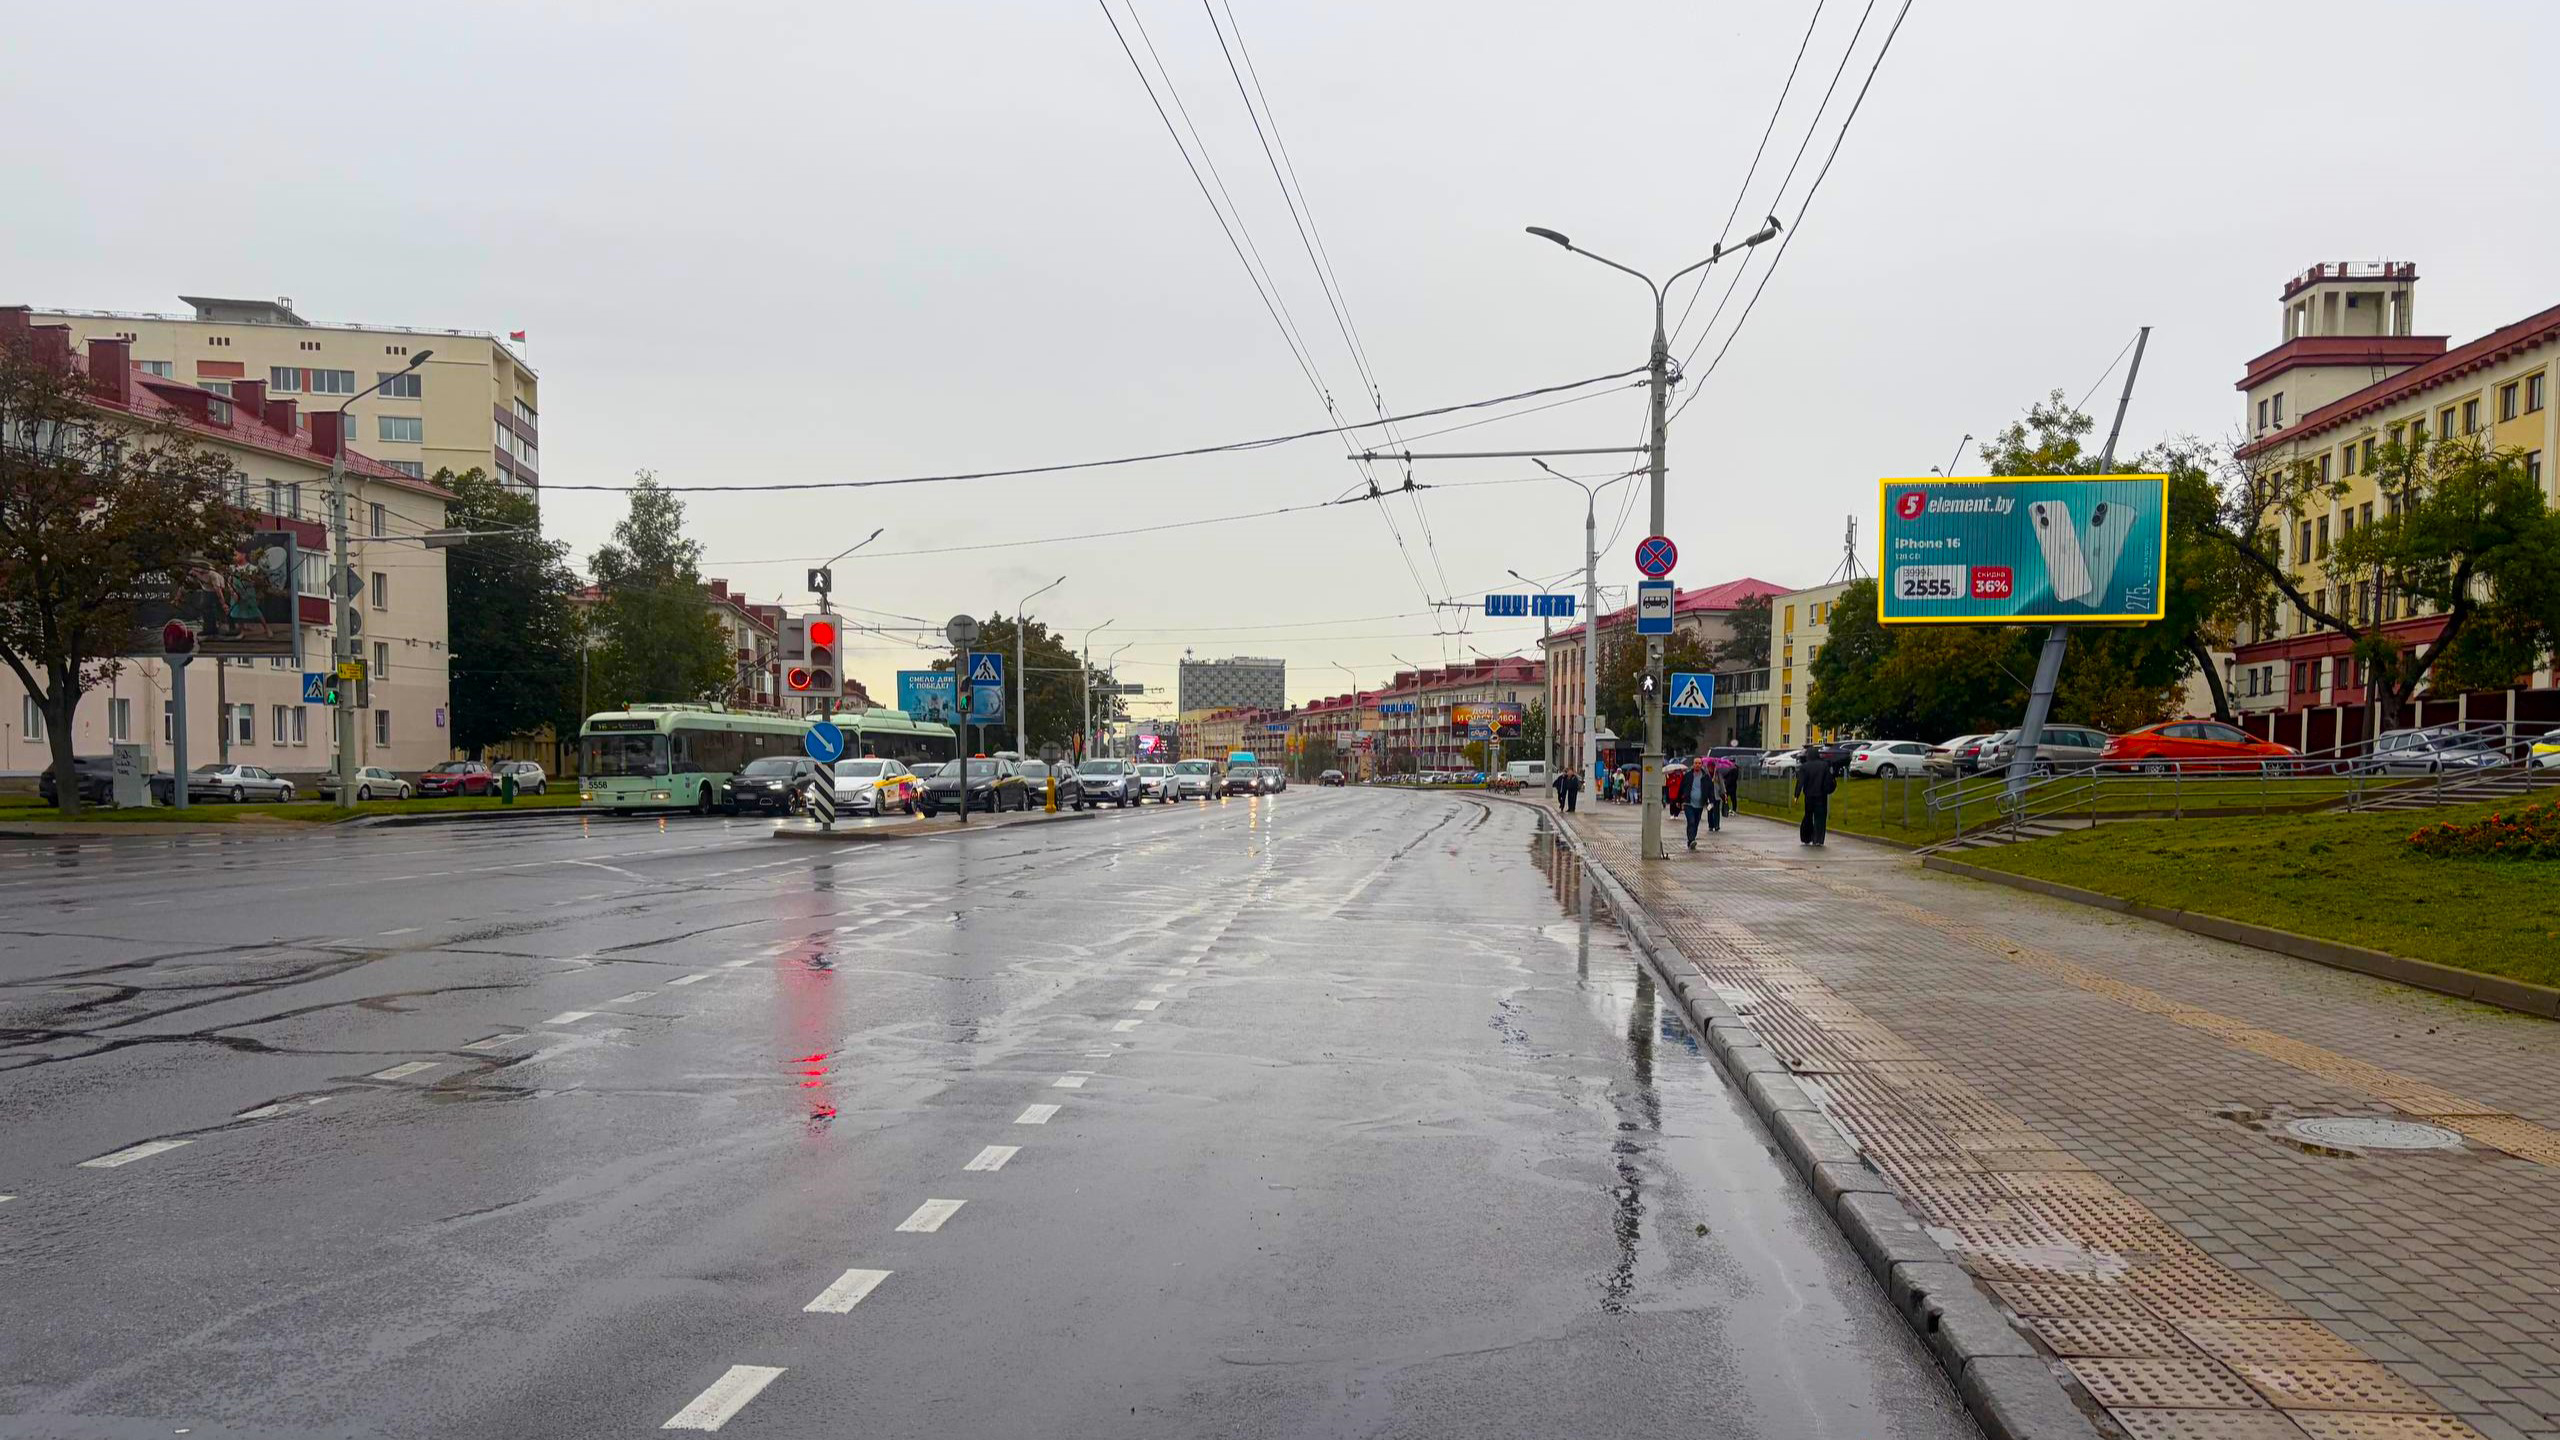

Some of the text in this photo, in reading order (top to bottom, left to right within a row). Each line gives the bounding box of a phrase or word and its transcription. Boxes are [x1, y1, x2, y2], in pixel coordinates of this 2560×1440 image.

[1904, 495, 2015, 515] 5 element.by
[1895, 537, 1961, 549] iPhone 16
[1976, 580, 2009, 593] 36%
